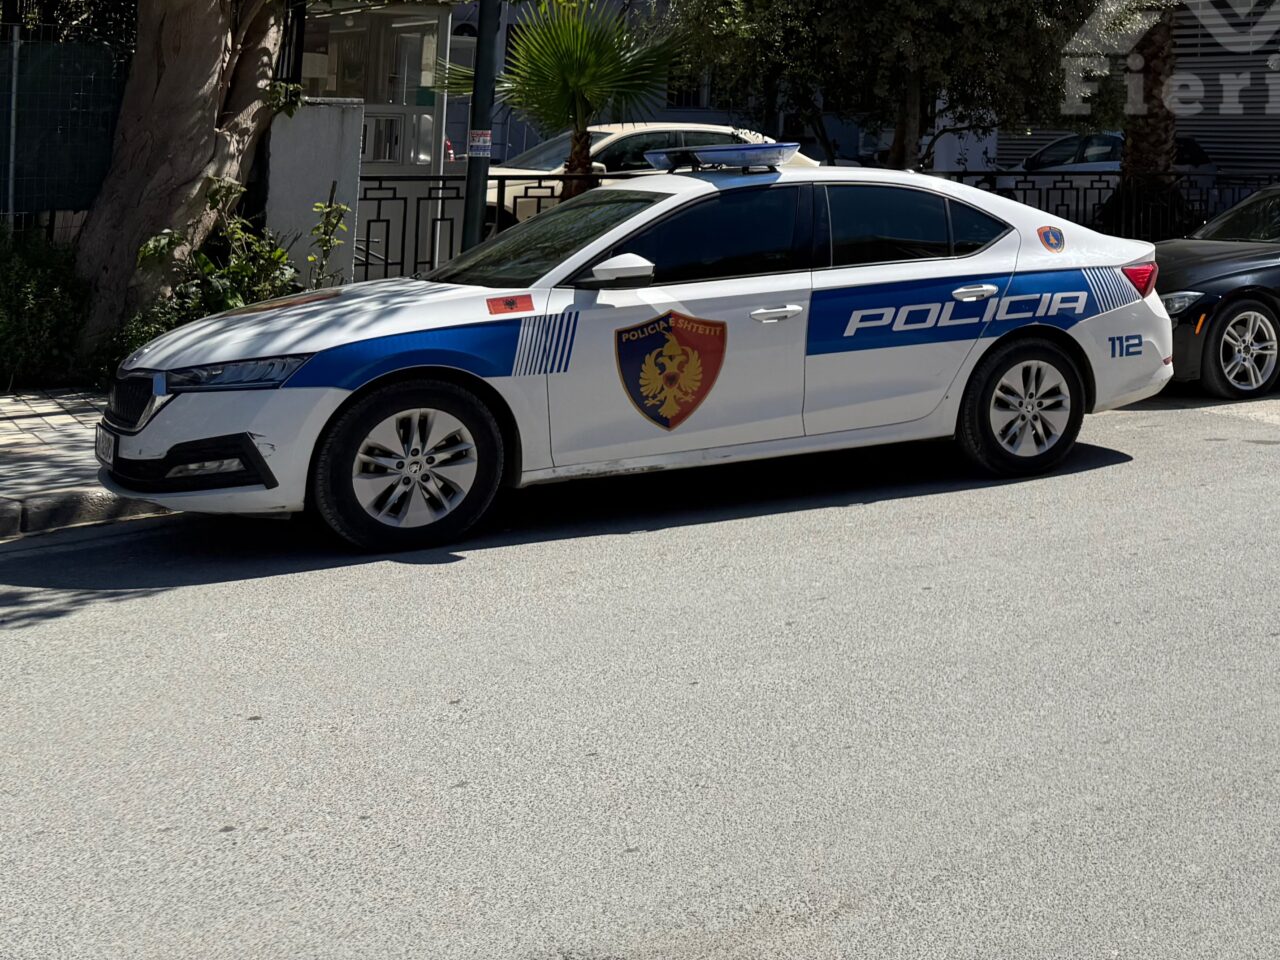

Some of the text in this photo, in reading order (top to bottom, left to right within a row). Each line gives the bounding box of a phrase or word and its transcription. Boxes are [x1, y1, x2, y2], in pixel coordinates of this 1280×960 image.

[843, 291, 1088, 337] POLICIA
[622, 321, 667, 342] POLICIA
[668, 318, 676, 327] E
[1108, 334, 1143, 358] 112
